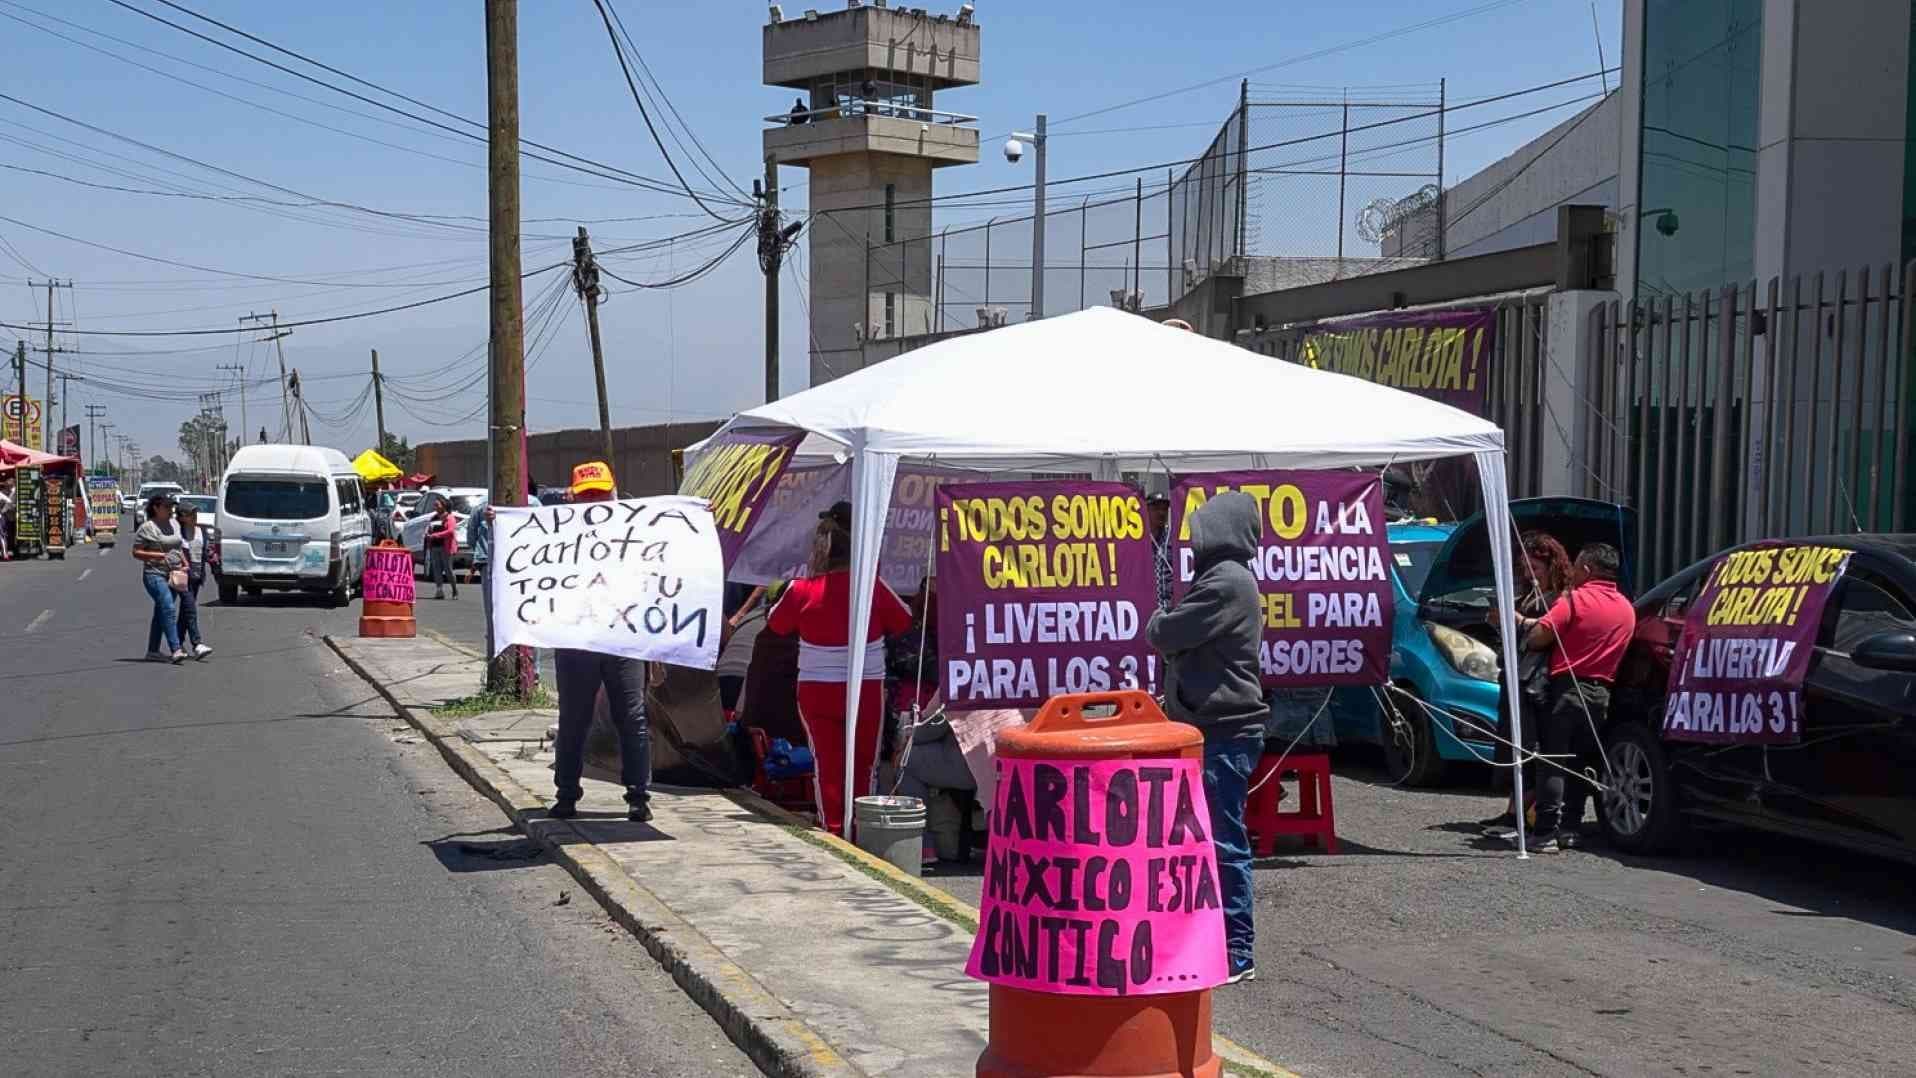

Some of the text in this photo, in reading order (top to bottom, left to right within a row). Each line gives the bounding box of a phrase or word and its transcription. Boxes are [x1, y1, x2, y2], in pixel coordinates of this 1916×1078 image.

[510, 503, 699, 538] APOYA
[1052, 495, 1144, 540] SOMOS
[1178, 484, 1374, 540] ATO A LA
[510, 572, 608, 595] TOCA
[1180, 546, 1387, 582] DNCUENCIA
[985, 601, 1139, 644] LIVERTAD
[1308, 592, 1383, 628] PARA
[948, 658, 1039, 700] PARA
[1048, 656, 1111, 695] LOS
[1118, 655, 1139, 693] 3
[1663, 691, 1725, 733] PARA
[1730, 692, 1764, 734] LOS
[1147, 855, 1220, 913] ESTA
